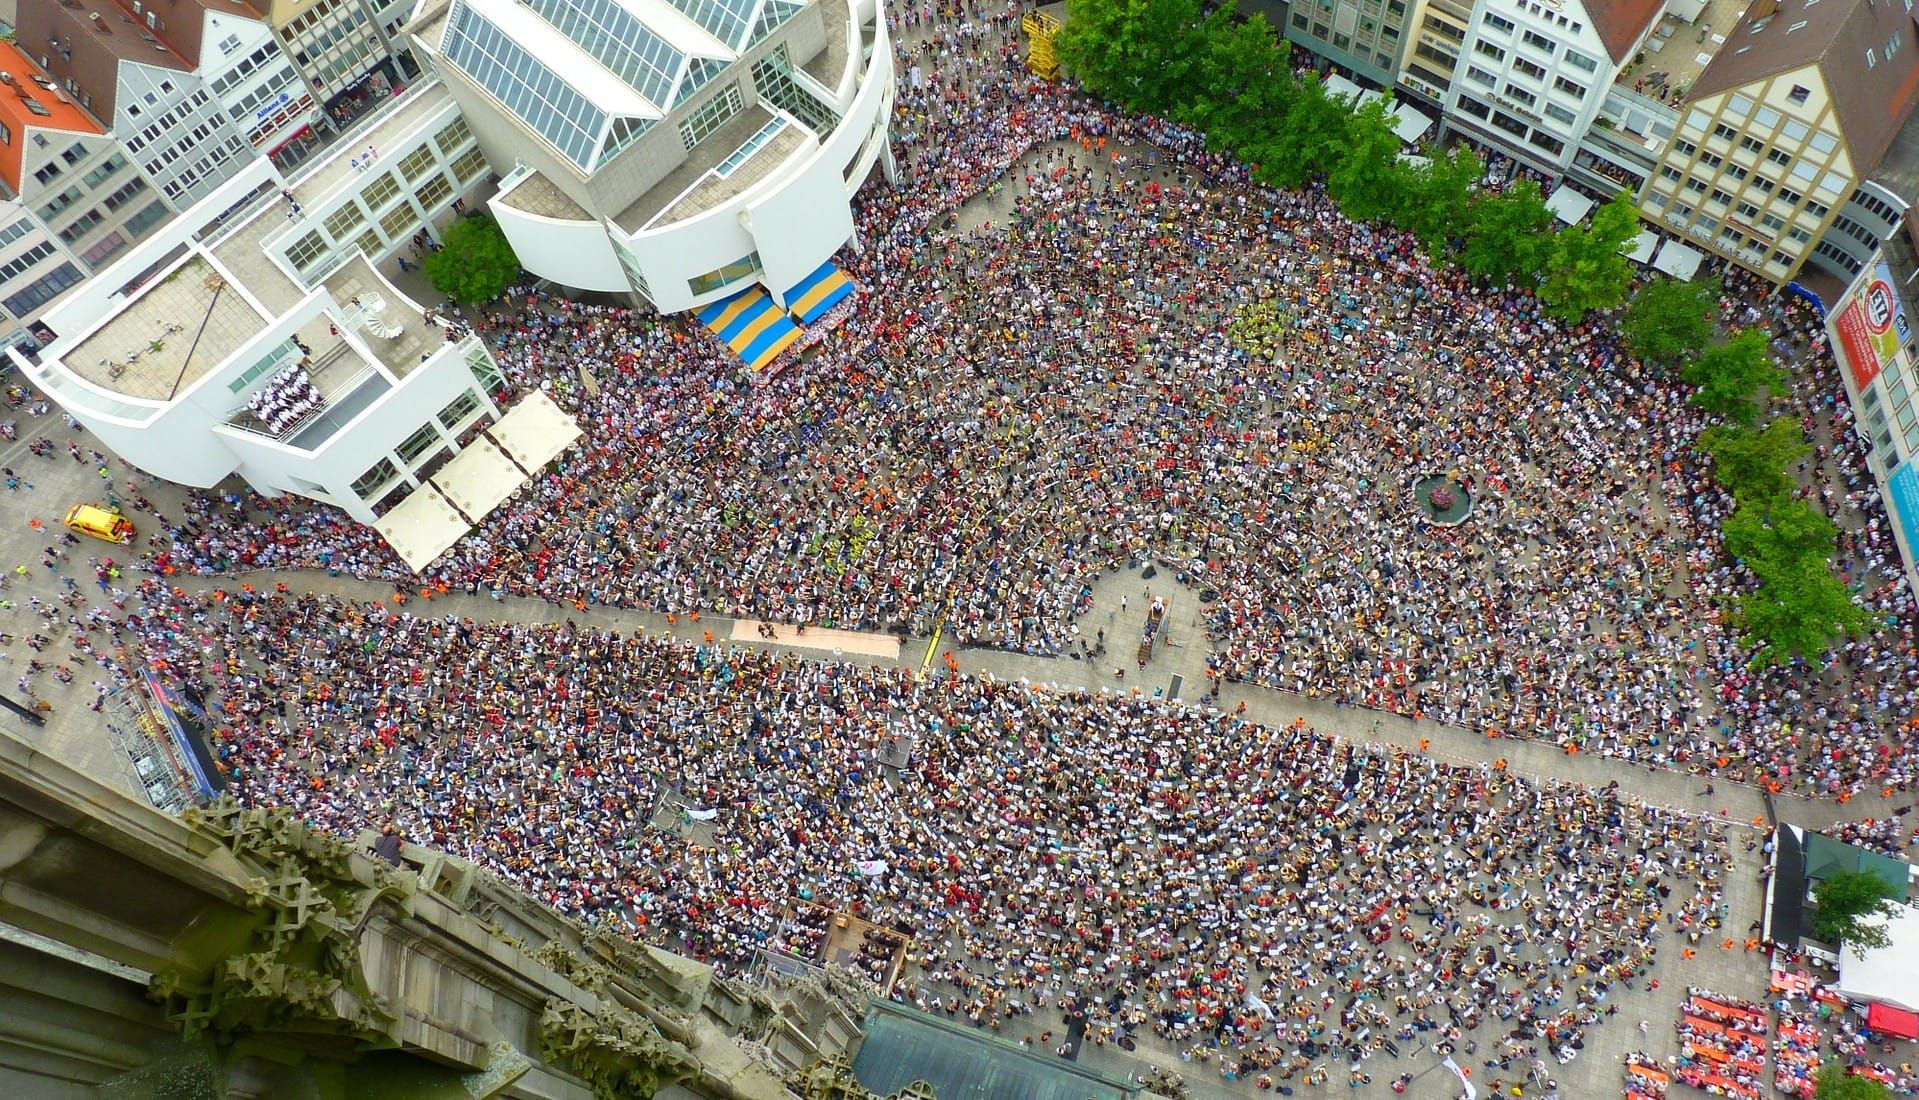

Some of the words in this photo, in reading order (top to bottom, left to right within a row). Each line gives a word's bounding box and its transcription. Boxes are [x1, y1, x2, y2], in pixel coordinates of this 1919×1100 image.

[257, 101, 280, 119] Allianz
[1496, 97, 1514, 110] Gold
[1712, 240, 1763, 269] HALLE
[1897, 316, 1907, 333] abt
